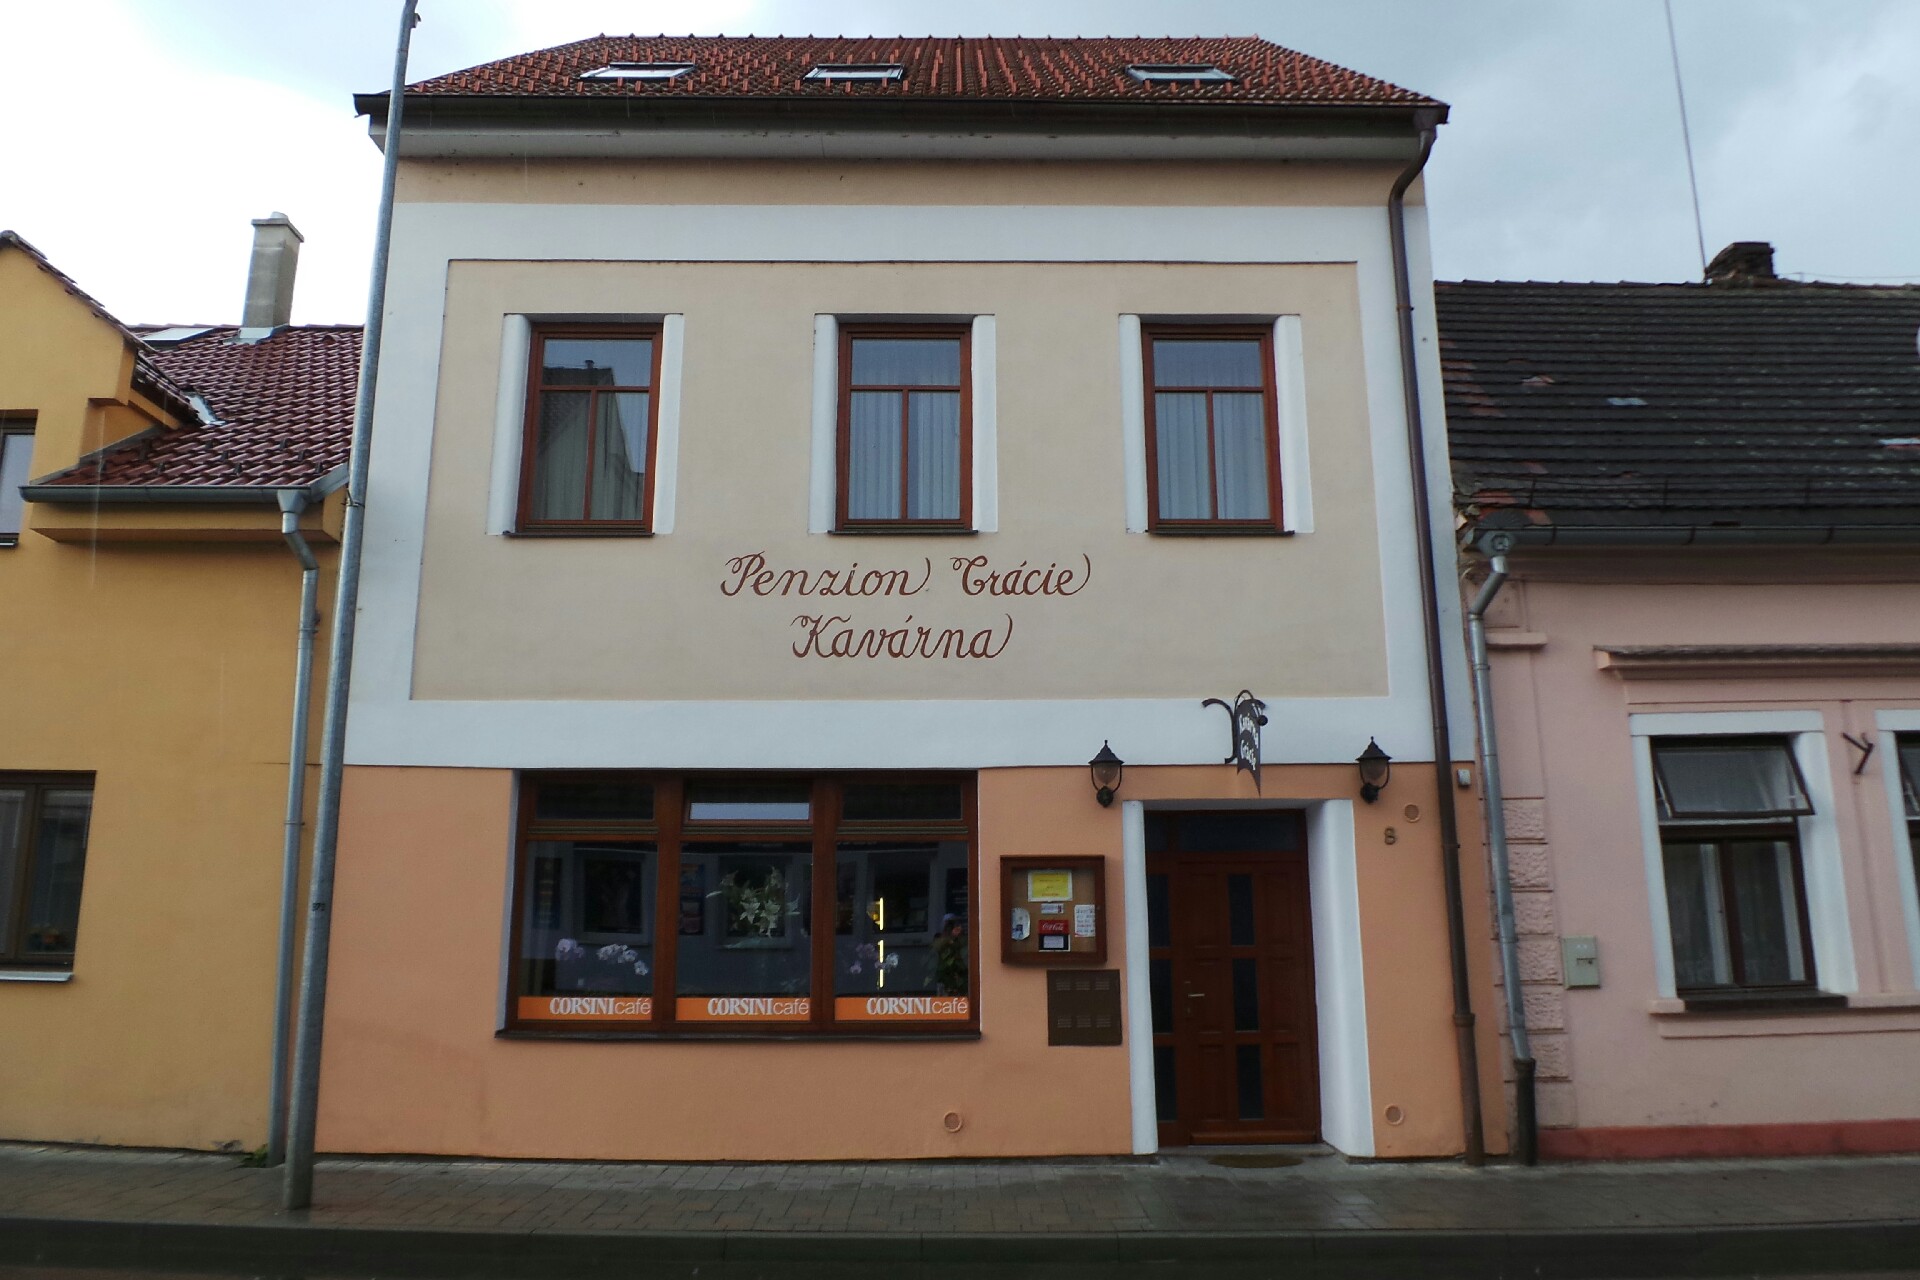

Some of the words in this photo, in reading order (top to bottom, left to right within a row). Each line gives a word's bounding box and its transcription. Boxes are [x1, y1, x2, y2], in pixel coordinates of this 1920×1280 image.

[720, 551, 931, 596] Penzion
[950, 553, 1091, 596] Grácie
[790, 613, 1014, 659] Kavárna
[1384, 827, 1397, 845] 8
